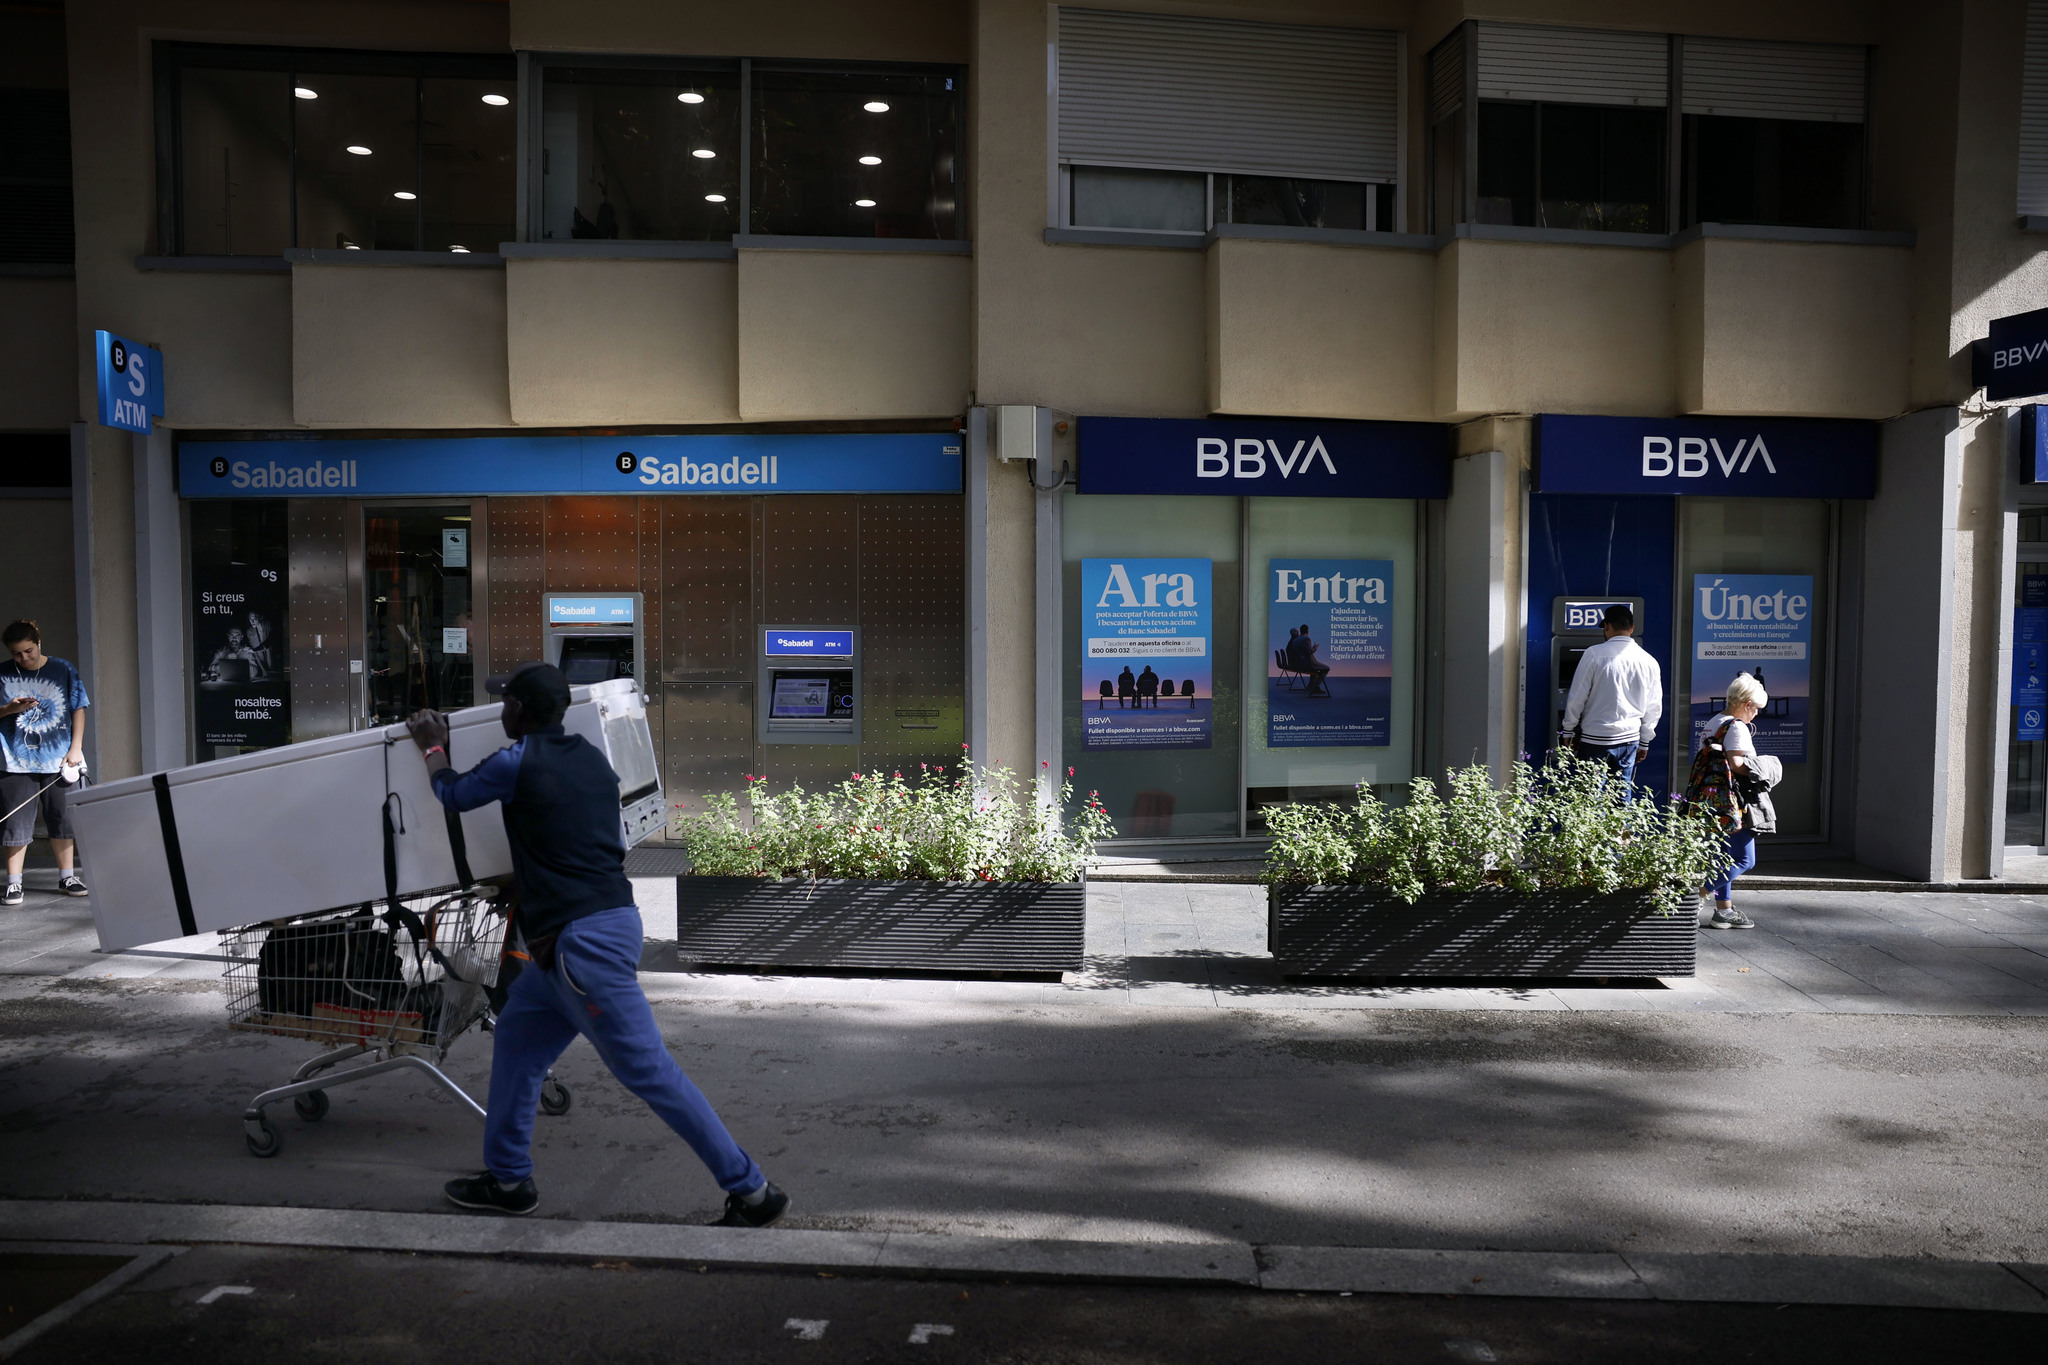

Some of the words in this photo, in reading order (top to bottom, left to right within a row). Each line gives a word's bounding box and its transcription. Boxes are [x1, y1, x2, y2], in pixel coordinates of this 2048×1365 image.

[1993, 338, 2048, 370] BBVA
[115, 347, 124, 366] B
[128, 353, 145, 397] S
[114, 398, 146, 429] ATM
[1196, 435, 1337, 479] BBVA
[1642, 433, 1777, 478] BBVA
[215, 461, 225, 473] B
[231, 460, 356, 488] Sabadell
[622, 457, 632, 469] B
[638, 455, 777, 485] Sabadell
[1096, 564, 1198, 608] Ara
[1275, 569, 1387, 604] Entra
[2027, 580, 2046, 588] BBVA
[202, 591, 213, 603] Si
[215, 593, 245, 603] creus
[1699, 578, 1807, 621] Únete
[202, 605, 216, 614] en
[219, 604, 233, 616] tu,
[559, 606, 596, 615] Sabadell
[1096, 611, 1112, 619] pots
[1112, 611, 1142, 619] acceptar
[1143, 610, 1168, 618] l'oferta
[1331, 607, 1360, 615] t'ajudem
[1568, 608, 1605, 626] BB
[1118, 627, 1127, 635] de
[782, 639, 814, 647] Sabadell
[234, 696, 282, 707] nosaltres
[235, 708, 272, 720] també.
[1273, 714, 1295, 722] BBVA
[1088, 717, 1111, 725] BBVA
[1694, 720, 1708, 728] BB
